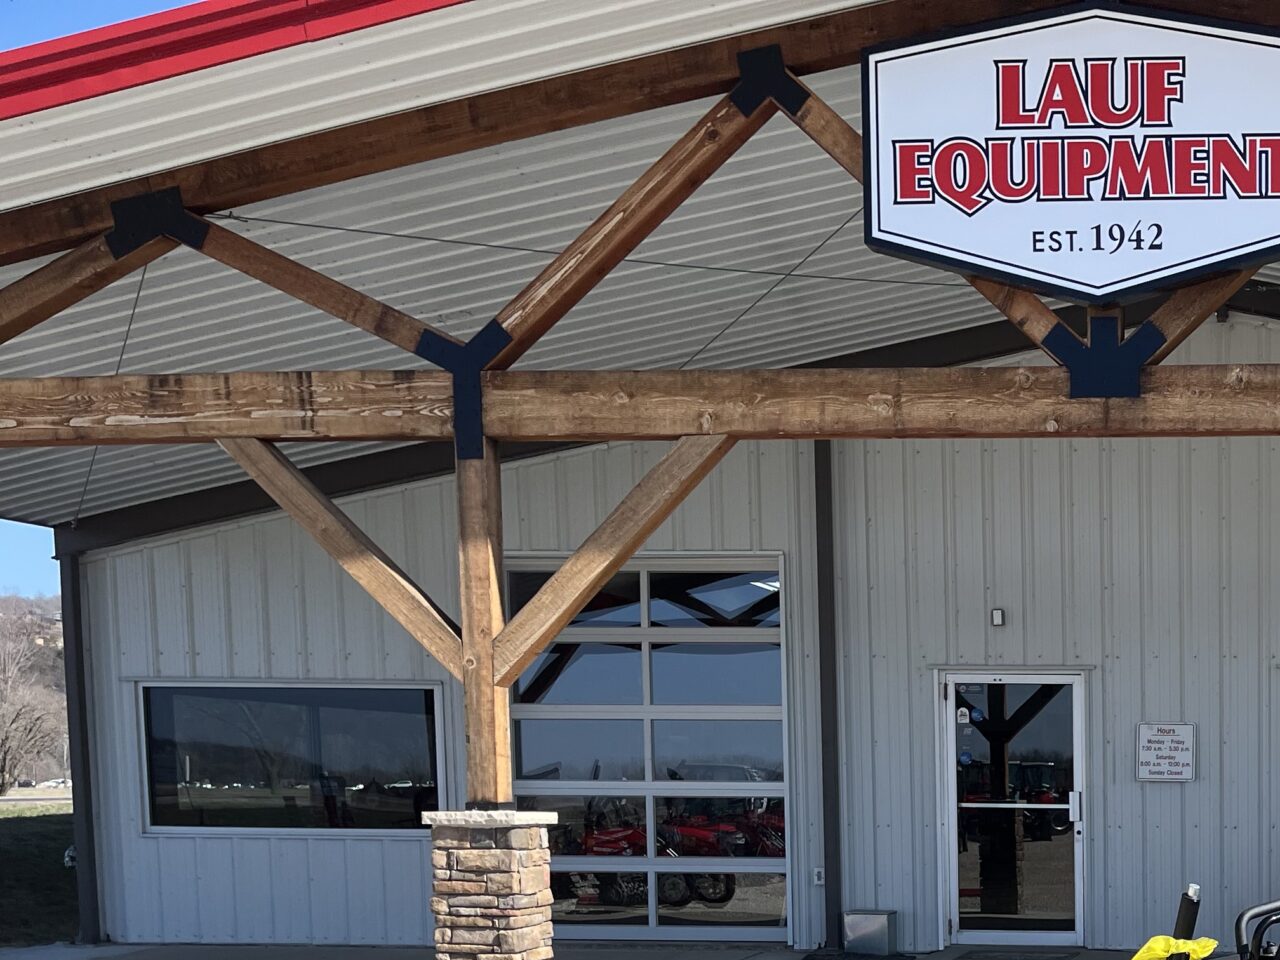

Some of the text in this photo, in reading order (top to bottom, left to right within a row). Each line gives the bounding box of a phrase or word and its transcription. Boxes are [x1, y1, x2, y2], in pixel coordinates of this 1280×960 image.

[994, 56, 1186, 130] LAUF
[1031, 219, 1164, 255] EST. 1942
[1156, 727, 1176, 735] Hours
